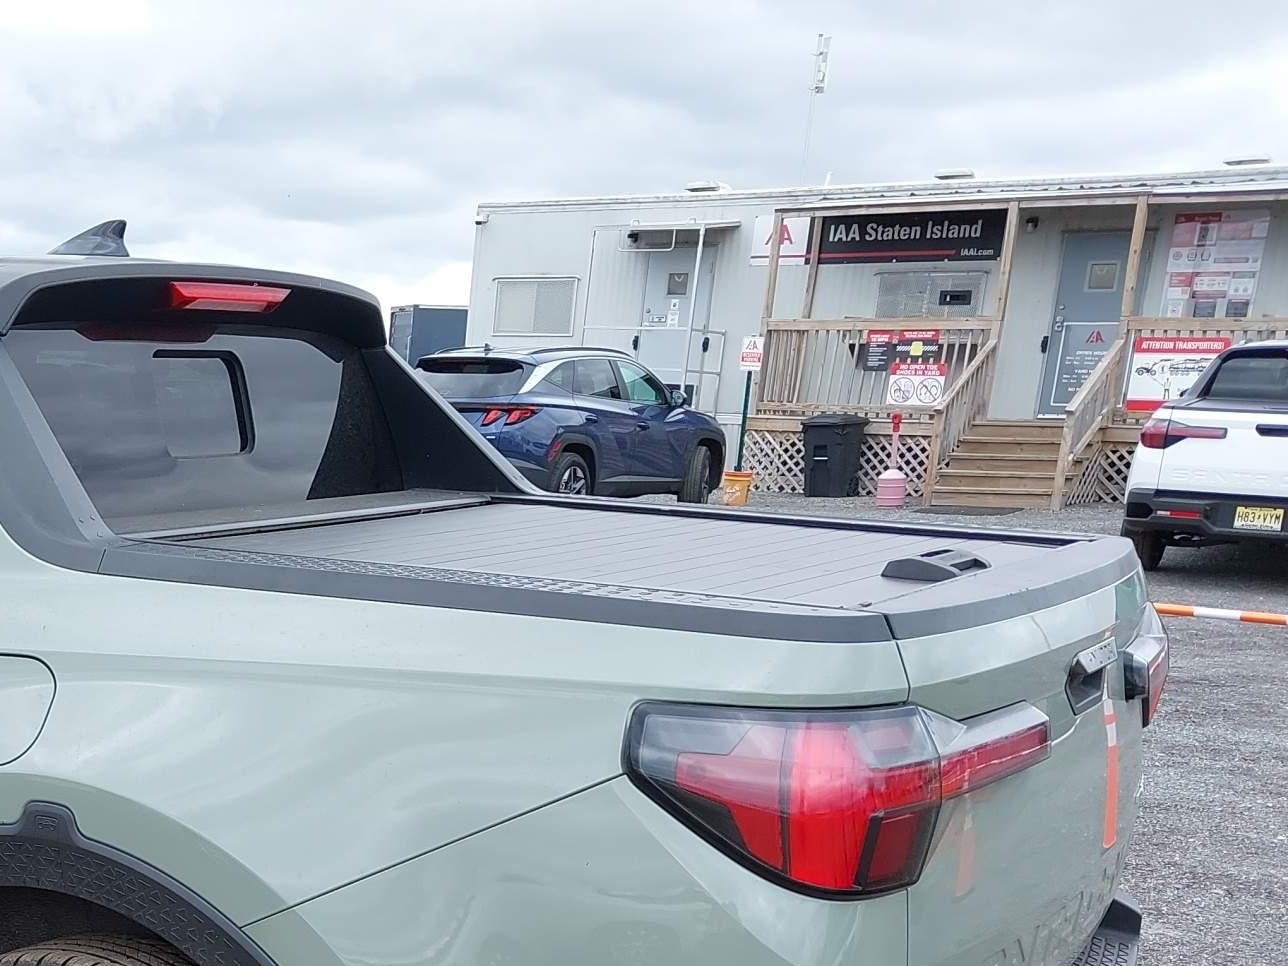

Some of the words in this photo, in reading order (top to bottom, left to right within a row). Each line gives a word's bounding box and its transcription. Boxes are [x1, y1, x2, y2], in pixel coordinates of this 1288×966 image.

[828, 223, 861, 242] IAA
[864, 222, 922, 242] Staten
[925, 219, 983, 239] Island
[1140, 340, 1174, 350] ATTENTION
[1174, 341, 1225, 350] TRANSPORTERS!
[1237, 511, 1256, 523] H83
[1262, 512, 1282, 525] VYM
